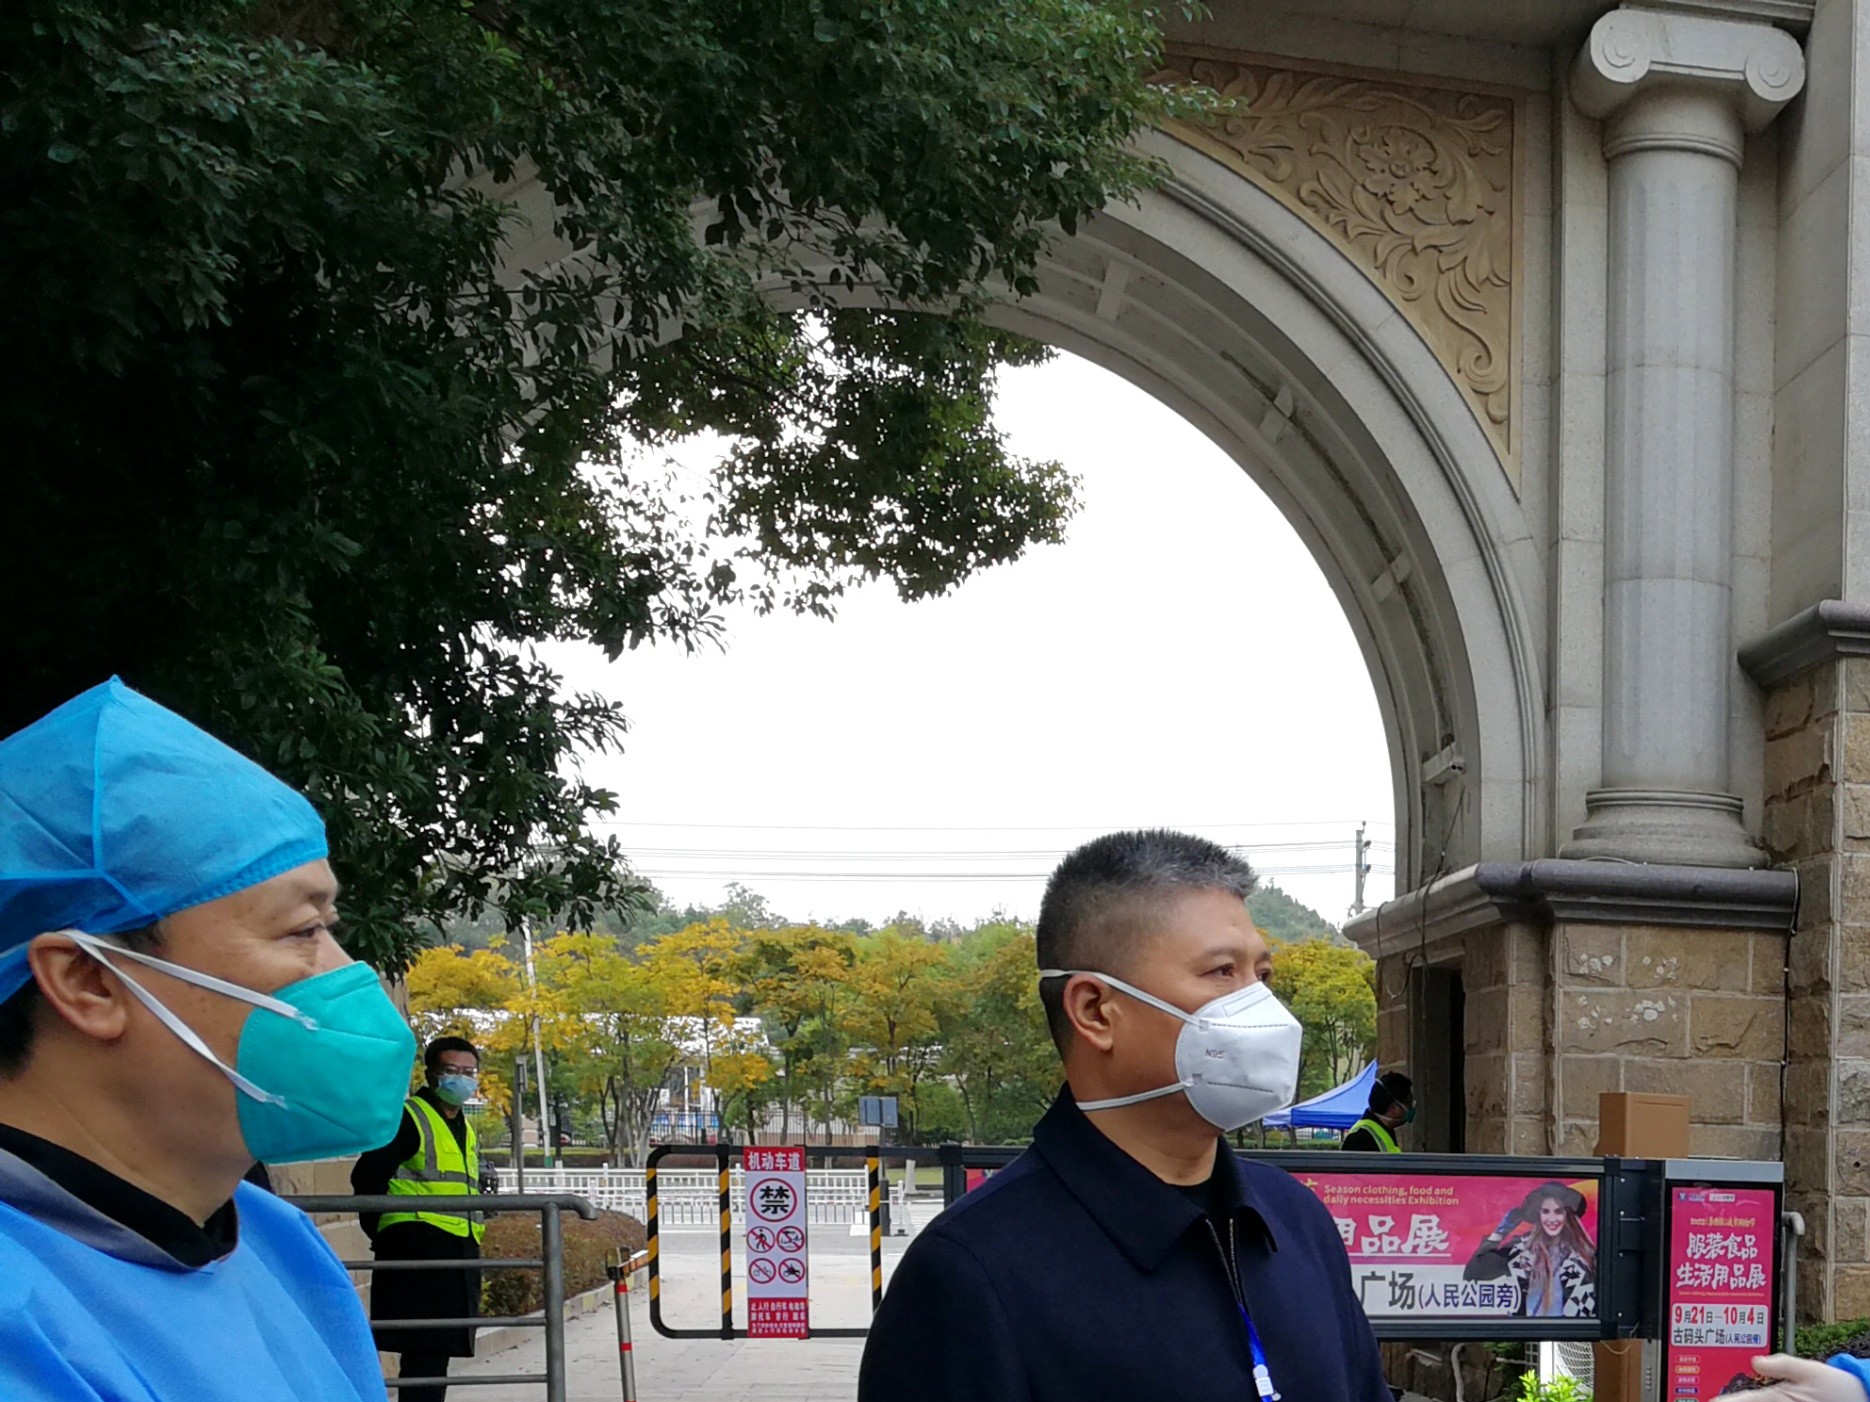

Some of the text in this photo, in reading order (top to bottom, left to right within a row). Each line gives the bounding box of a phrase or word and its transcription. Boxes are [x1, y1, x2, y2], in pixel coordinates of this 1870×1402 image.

[1205, 1048, 1225, 1060] N95
[748, 1151, 801, 1171] 机动车道
[760, 1185, 790, 1215] 禁
[1324, 1184, 1454, 1197] Season clothing, food and
[1324, 1195, 1460, 1206] daily necessities Exhibition
[1686, 1232, 1758, 1260] 服装食品
[1676, 1262, 1767, 1290] 生活用品展
